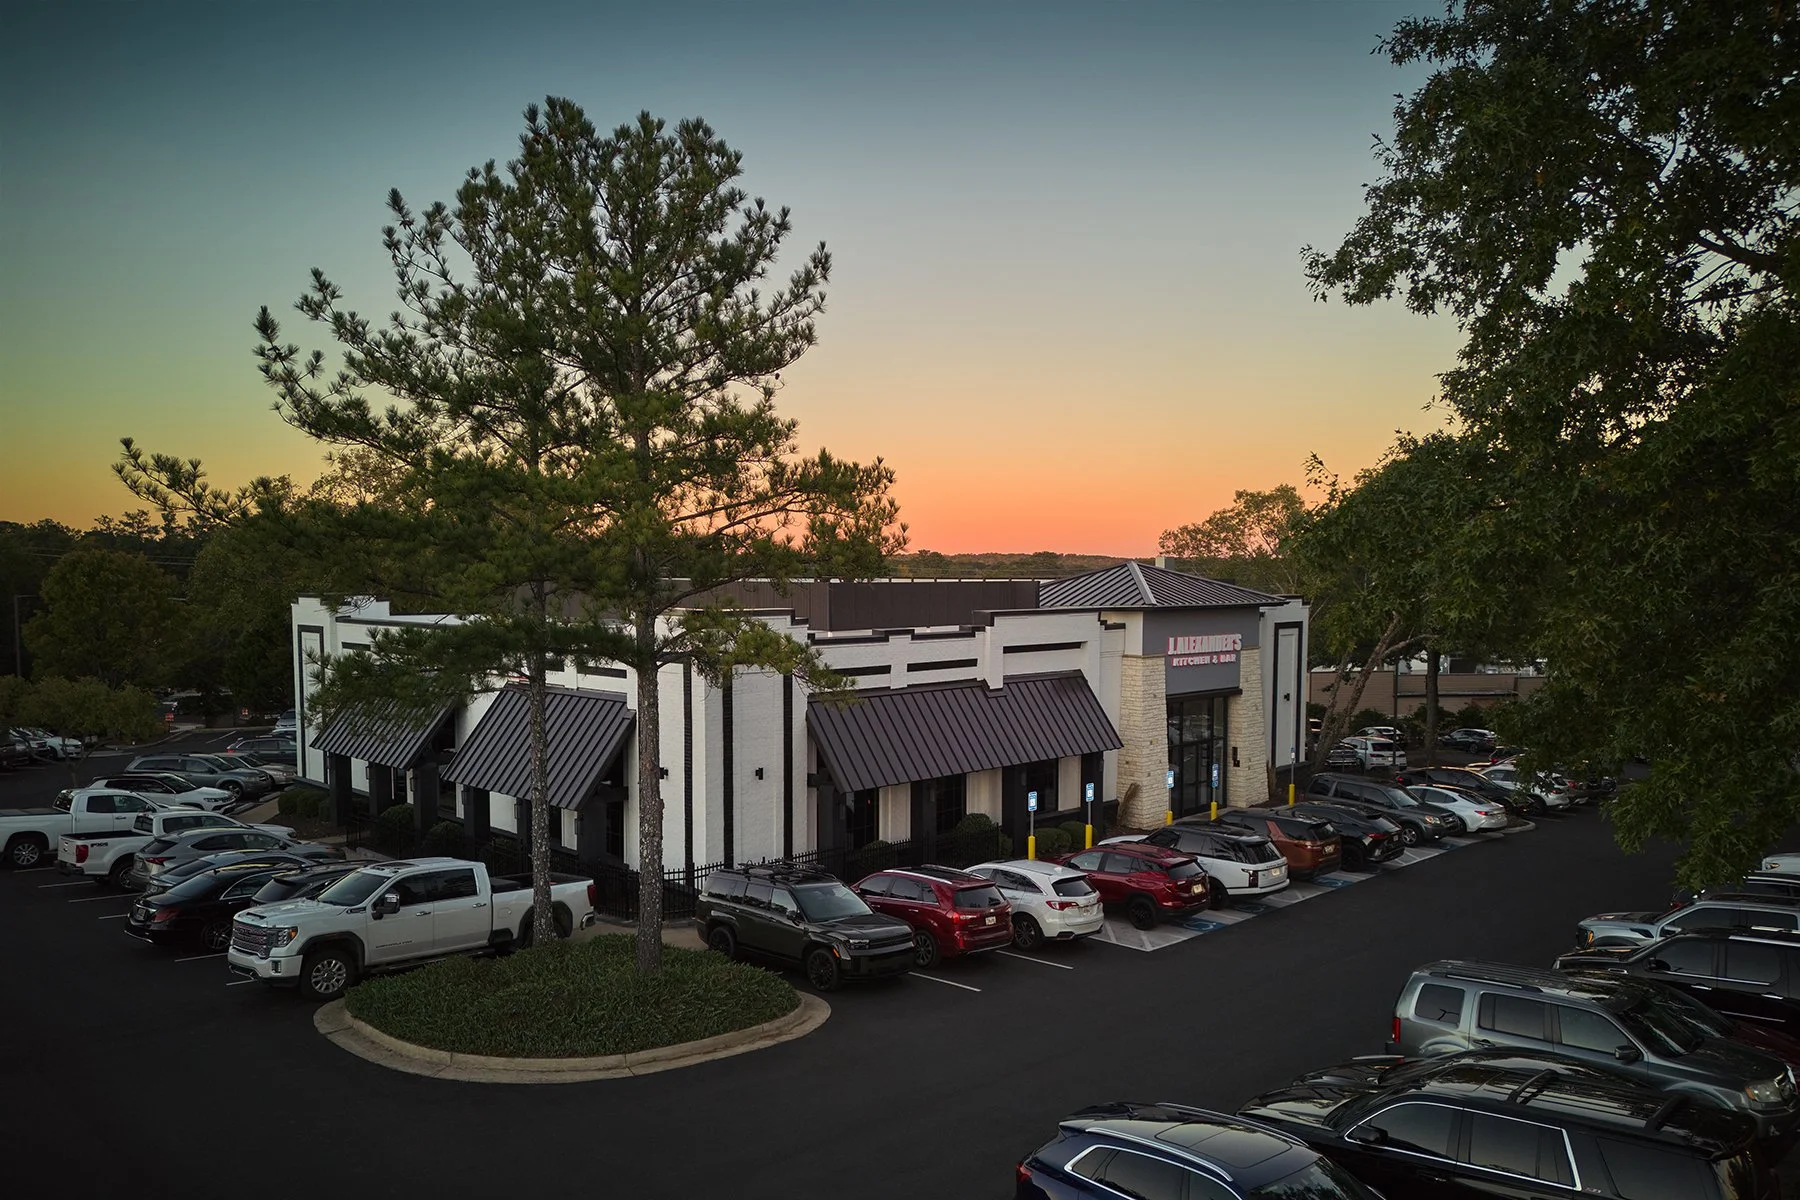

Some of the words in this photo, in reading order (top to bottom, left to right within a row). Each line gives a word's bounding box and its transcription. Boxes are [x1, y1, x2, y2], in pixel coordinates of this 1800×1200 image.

[1172, 656, 1211, 666] KITCHEN
[1212, 655, 1218, 664] &
[1219, 654, 1236, 663] BAR
